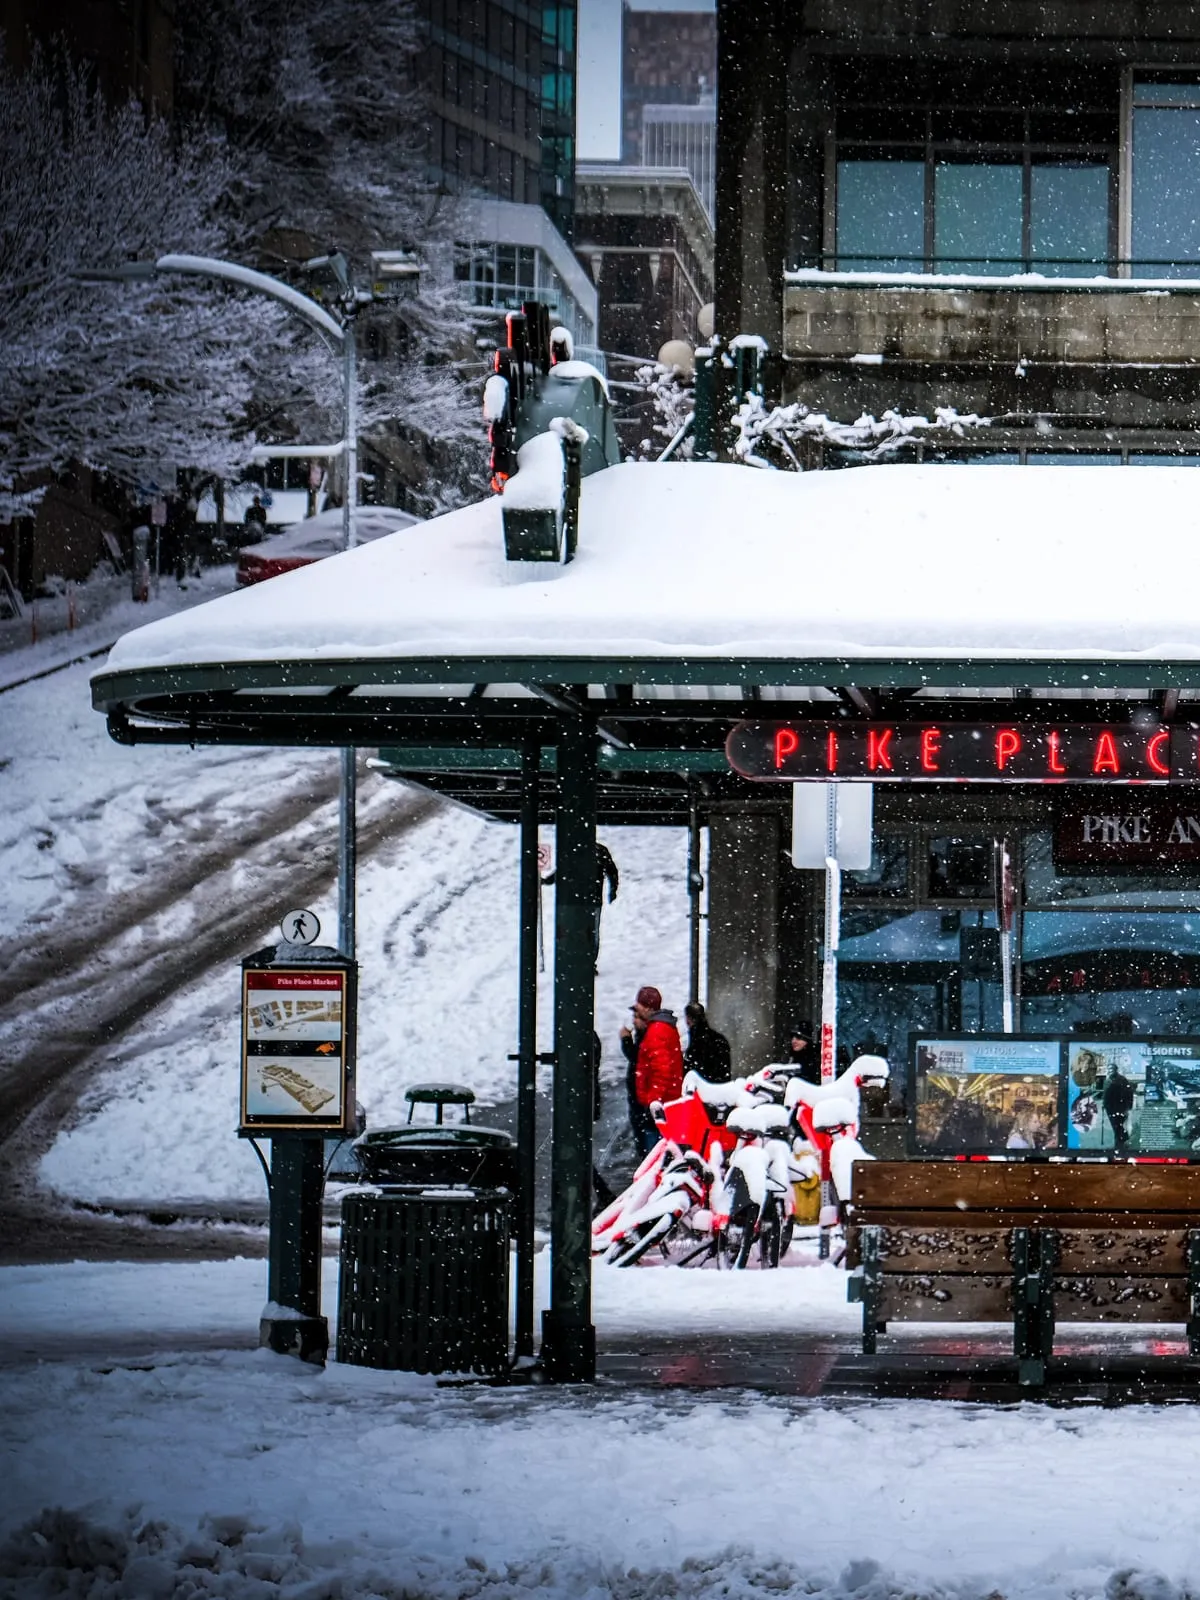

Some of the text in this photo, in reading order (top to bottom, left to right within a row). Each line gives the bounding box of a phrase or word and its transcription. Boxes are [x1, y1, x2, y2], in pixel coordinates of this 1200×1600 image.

[774, 728, 942, 772] PIKE
[1081, 815, 1150, 844] PIKE
[1140, 1046, 1193, 1056] RESIDENTS
